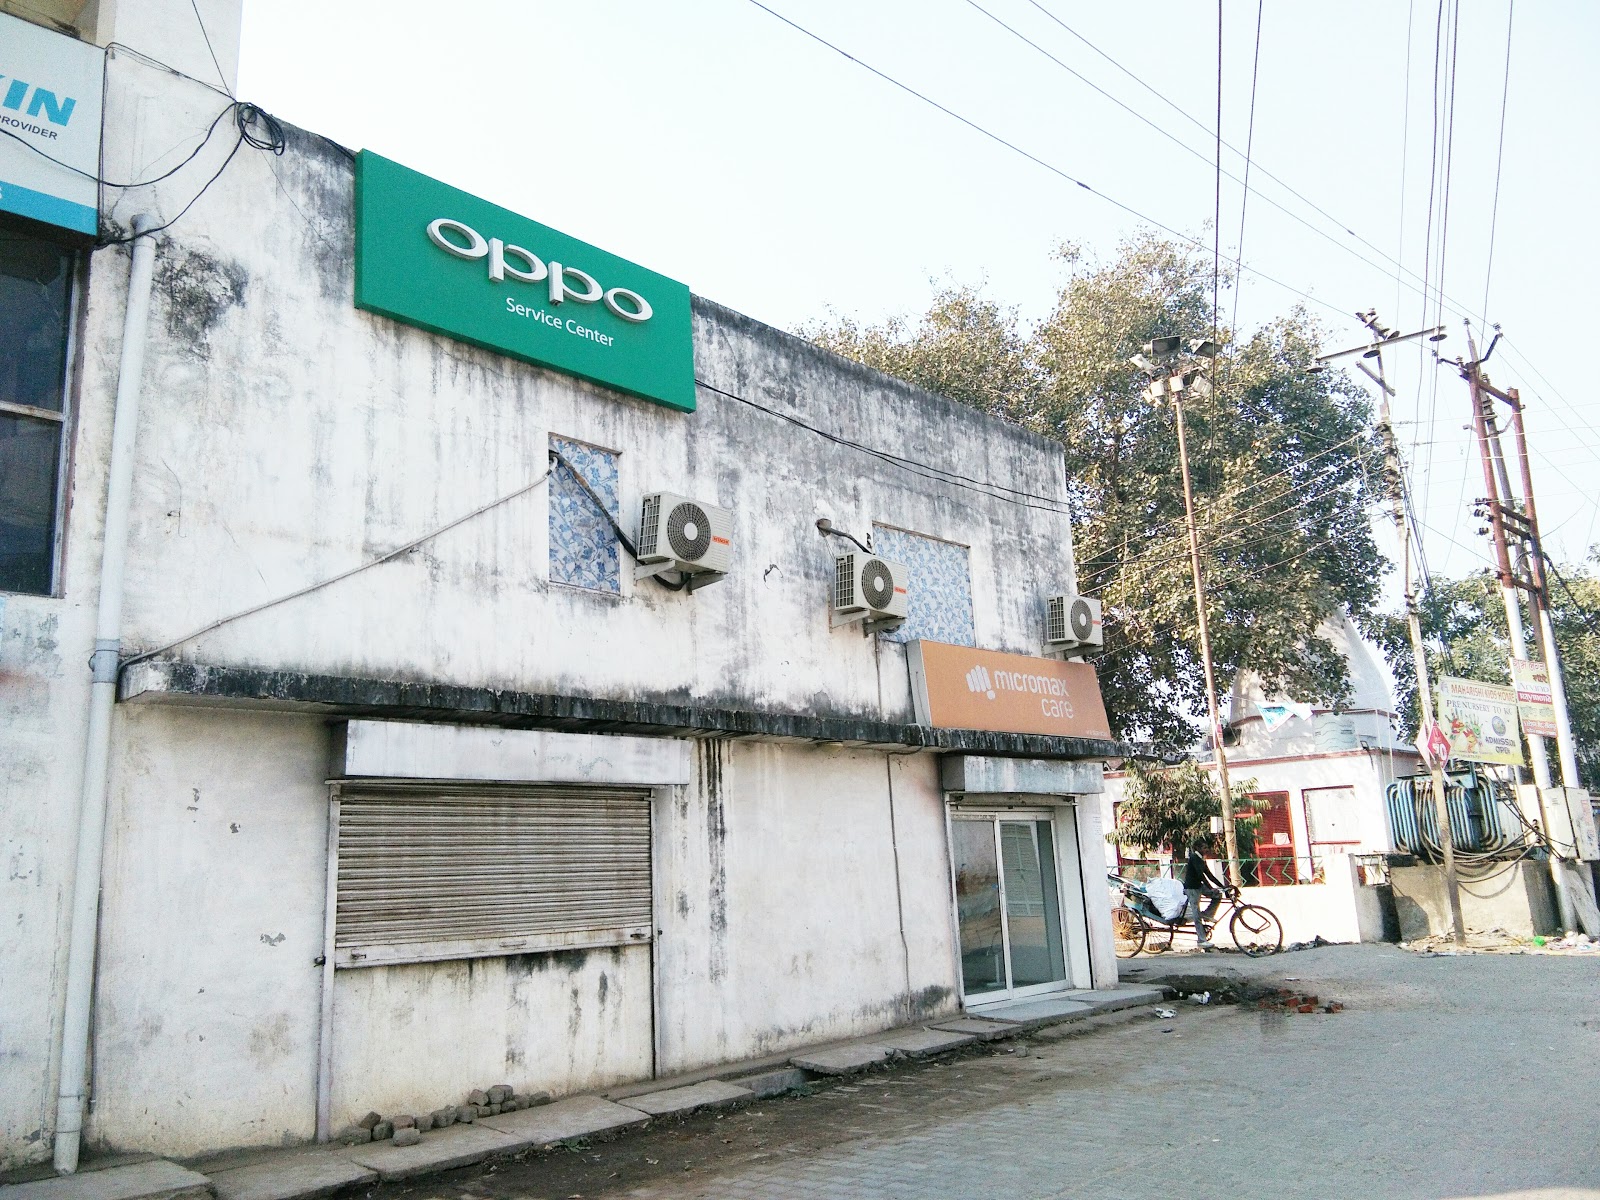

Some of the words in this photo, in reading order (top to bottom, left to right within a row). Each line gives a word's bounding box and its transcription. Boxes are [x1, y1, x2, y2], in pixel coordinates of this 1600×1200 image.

[0, 74, 77, 127] IN
[505, 297, 563, 330] Service
[565, 319, 614, 347] Center
[994, 670, 1069, 697] micromax
[1451, 684, 1484, 697] MAHARISHI
[1041, 698, 1074, 719] care
